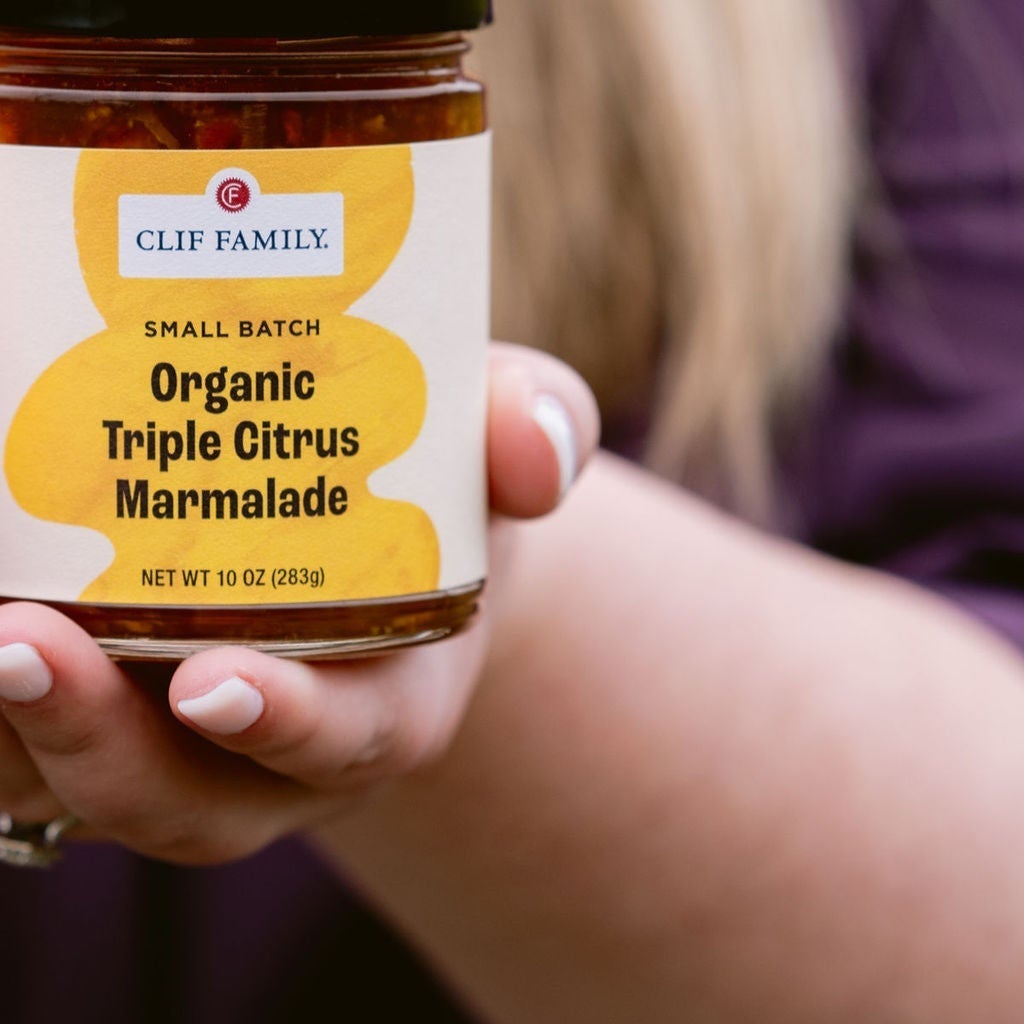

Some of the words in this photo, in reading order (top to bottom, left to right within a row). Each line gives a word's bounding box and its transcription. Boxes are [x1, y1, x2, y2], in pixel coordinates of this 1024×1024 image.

[136, 229, 204, 251] CLIF
[144, 320, 229, 338] SMALL
[239, 318, 320, 338] BATCH
[150, 361, 315, 414] Organic
[102, 420, 222, 471] Triple
[233, 420, 360, 461] Citrus
[116, 476, 348, 520] Marmalade
[141, 569, 177, 587] NET
[181, 569, 211, 587] WT
[217, 569, 237, 587] 10
[242, 568, 266, 587] OZ
[271, 567, 325, 589] (283g)
